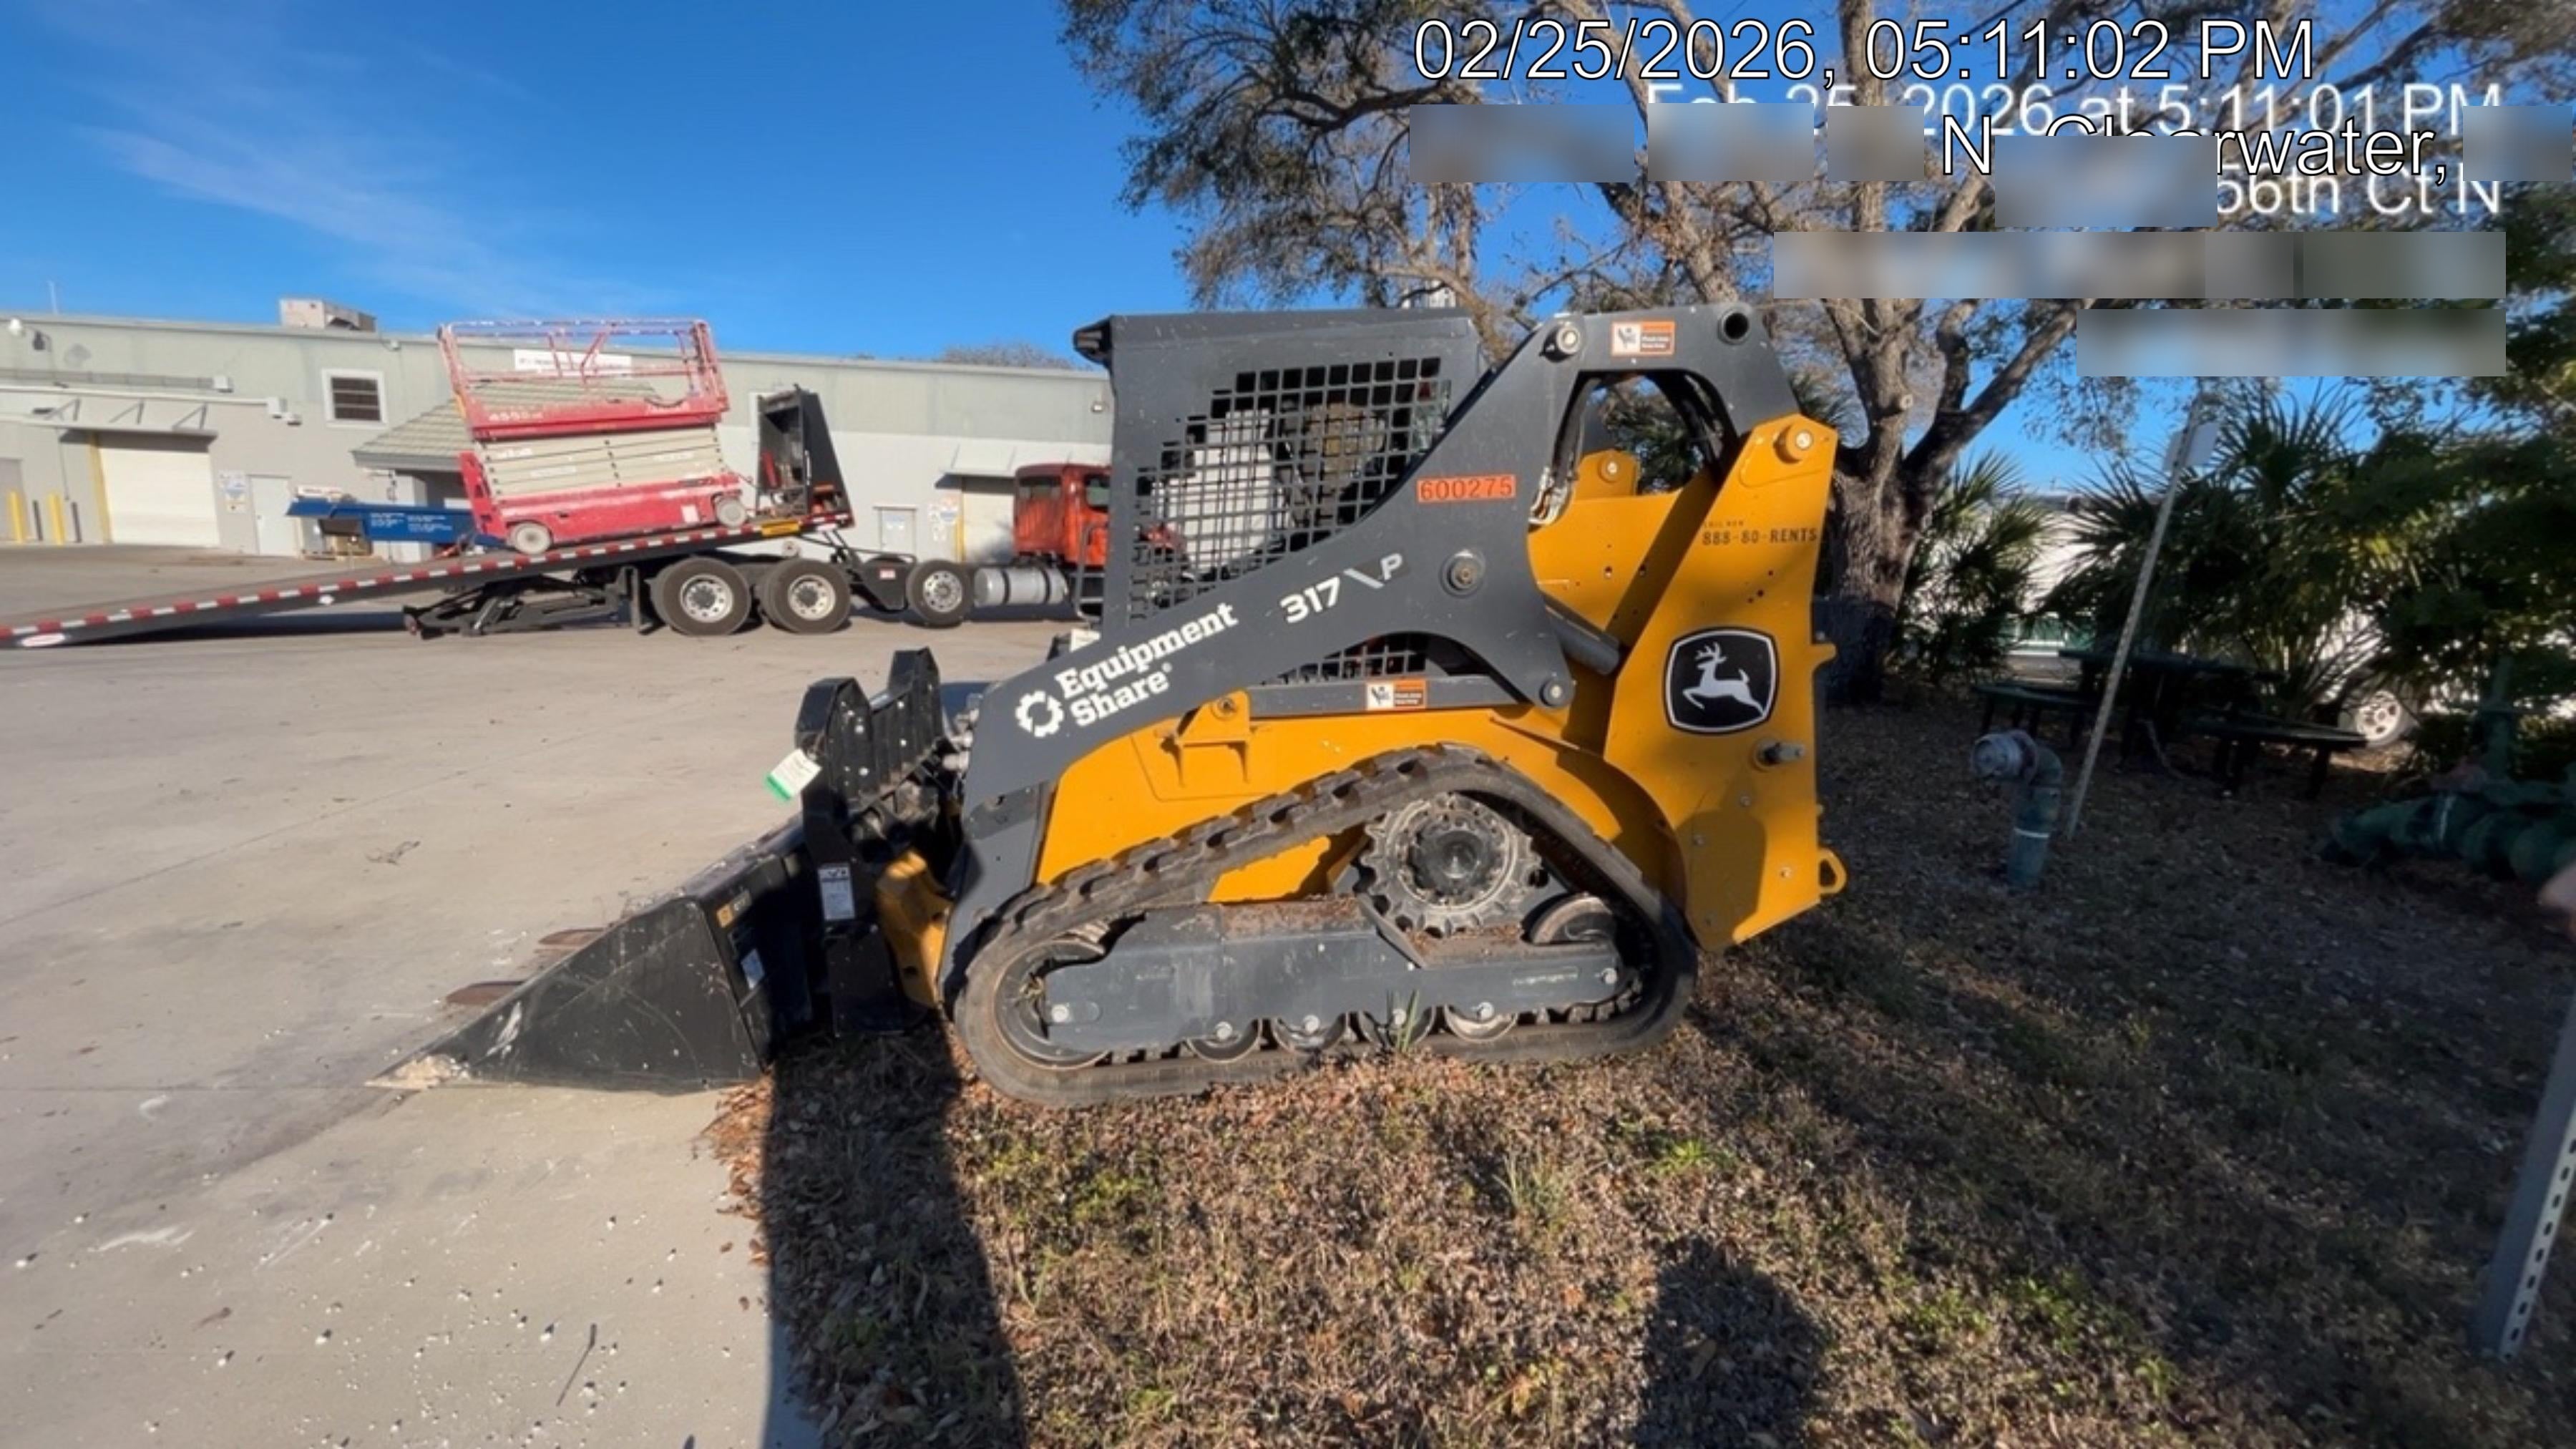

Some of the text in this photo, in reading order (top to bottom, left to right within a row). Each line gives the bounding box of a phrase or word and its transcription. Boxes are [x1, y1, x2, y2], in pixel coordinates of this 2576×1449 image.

[1420, 477, 1513, 500] 600275
[1280, 576, 1341, 623] 317
[1054, 602, 1239, 699] Equipment
